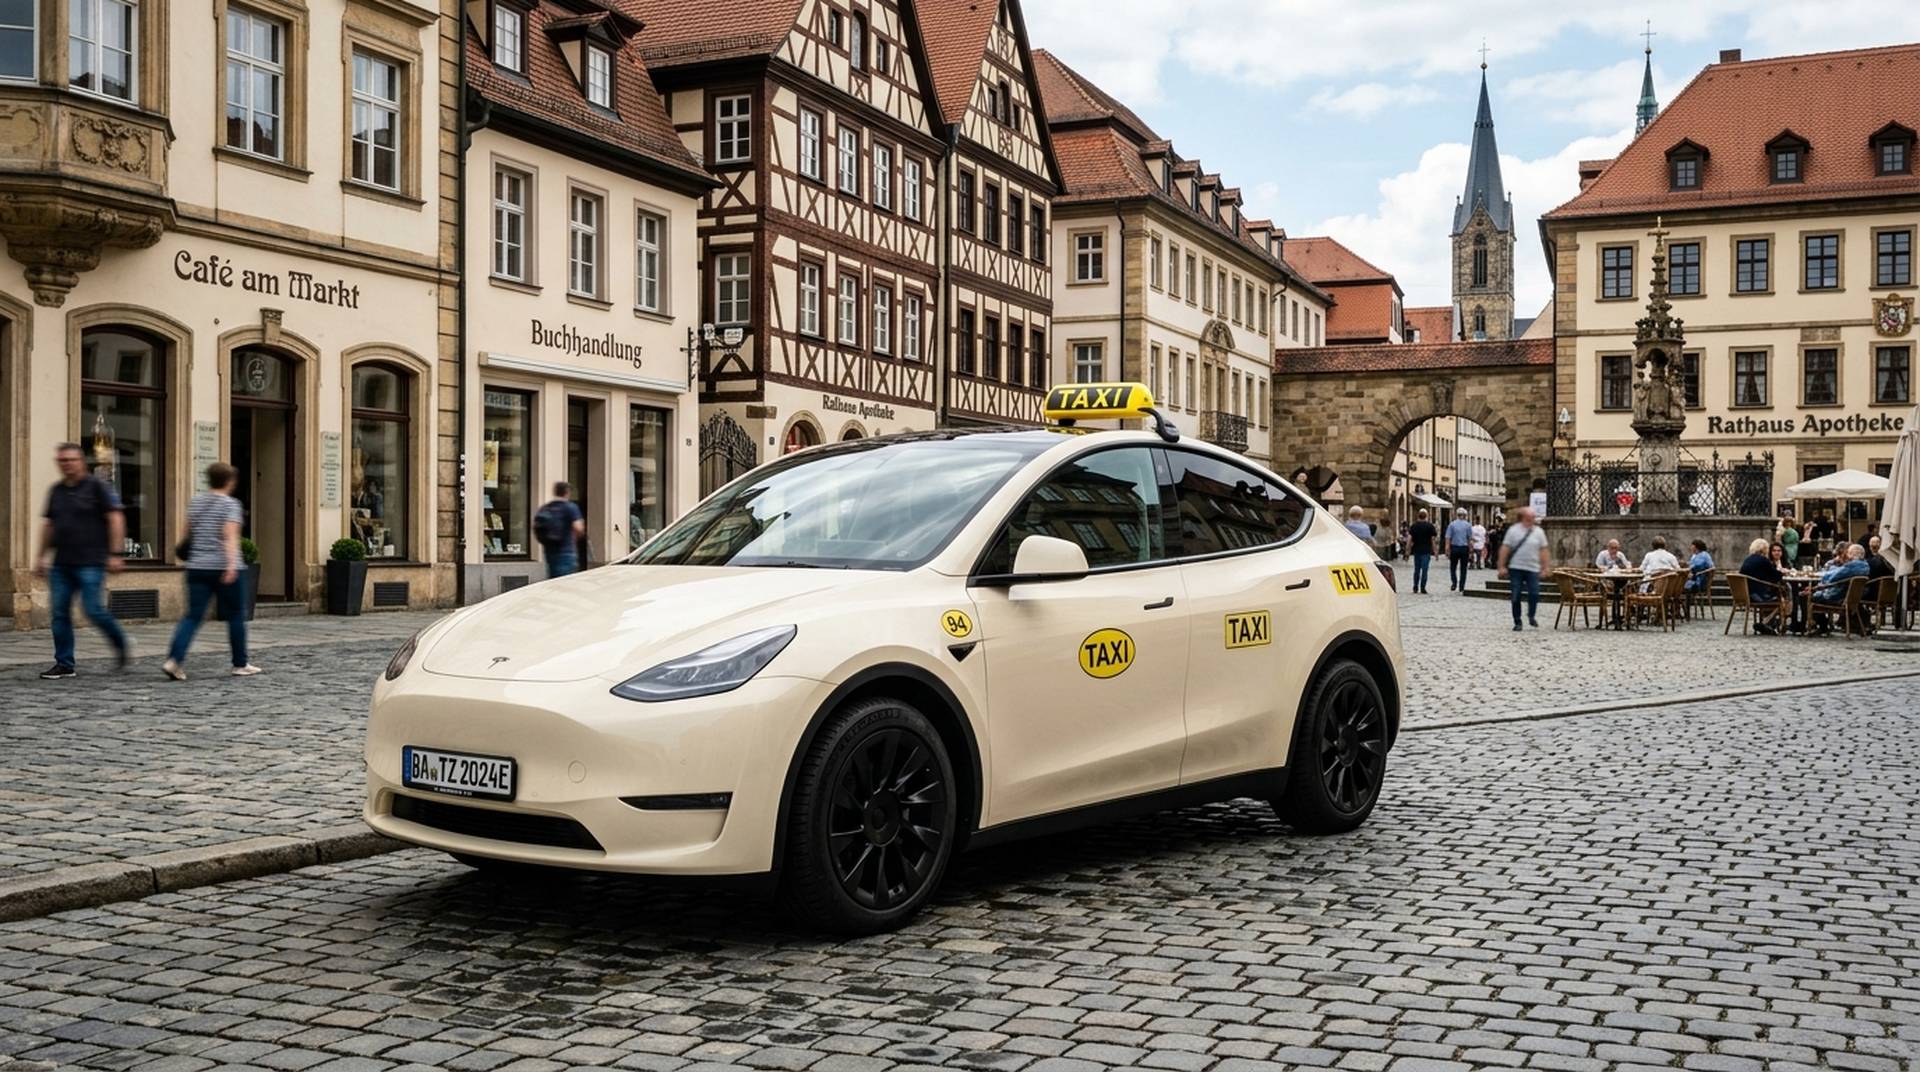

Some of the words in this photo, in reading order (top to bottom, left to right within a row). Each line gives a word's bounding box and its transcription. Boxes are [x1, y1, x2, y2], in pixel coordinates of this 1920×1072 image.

[174, 249, 234, 288] Café
[241, 269, 280, 296] am
[288, 269, 360, 309] Markt
[531, 319, 642, 369] Buchhandlung
[1058, 387, 1124, 409] TAXI
[1707, 415, 1795, 437] Rathaus
[1801, 412, 1905, 437] Apotheke
[1331, 567, 1370, 592] TAXI
[946, 615, 968, 633] 94
[1228, 615, 1268, 644] TAXI
[1084, 639, 1129, 669] TAXI
